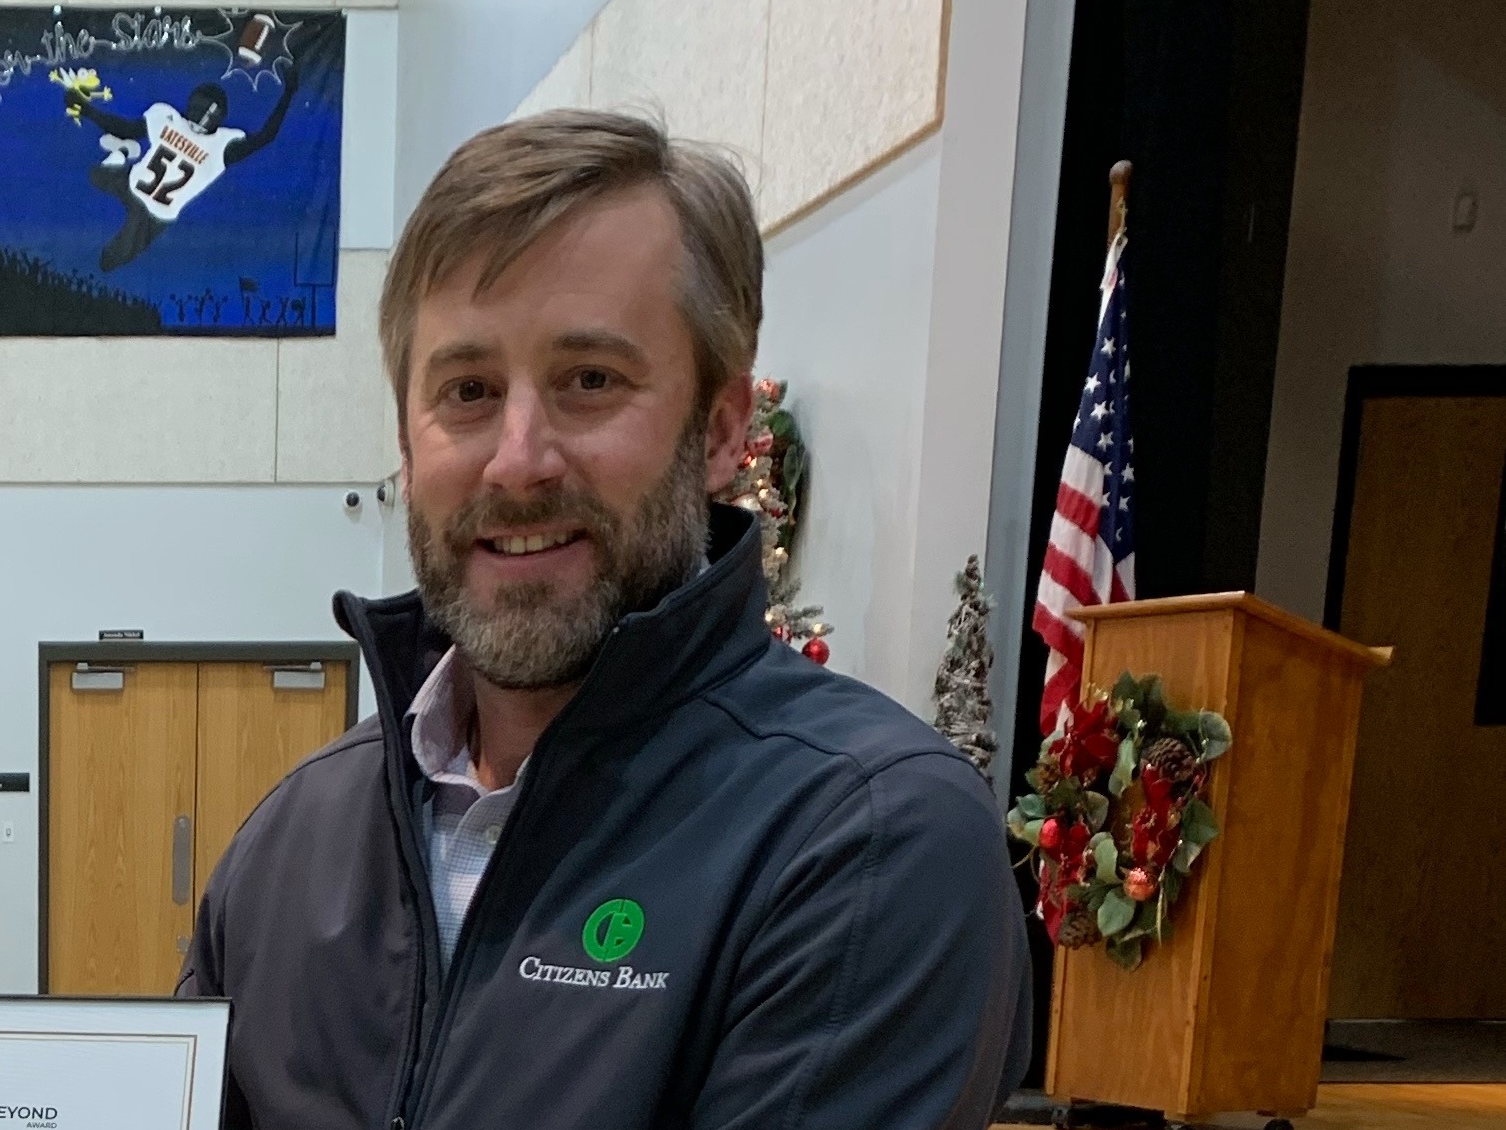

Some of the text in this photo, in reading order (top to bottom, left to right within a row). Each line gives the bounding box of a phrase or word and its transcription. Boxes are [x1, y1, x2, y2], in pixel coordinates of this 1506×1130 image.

[135, 144, 195, 206] 52
[519, 956, 670, 990] CITIZENS BANK
[26, 1121, 57, 1129] AWARD
